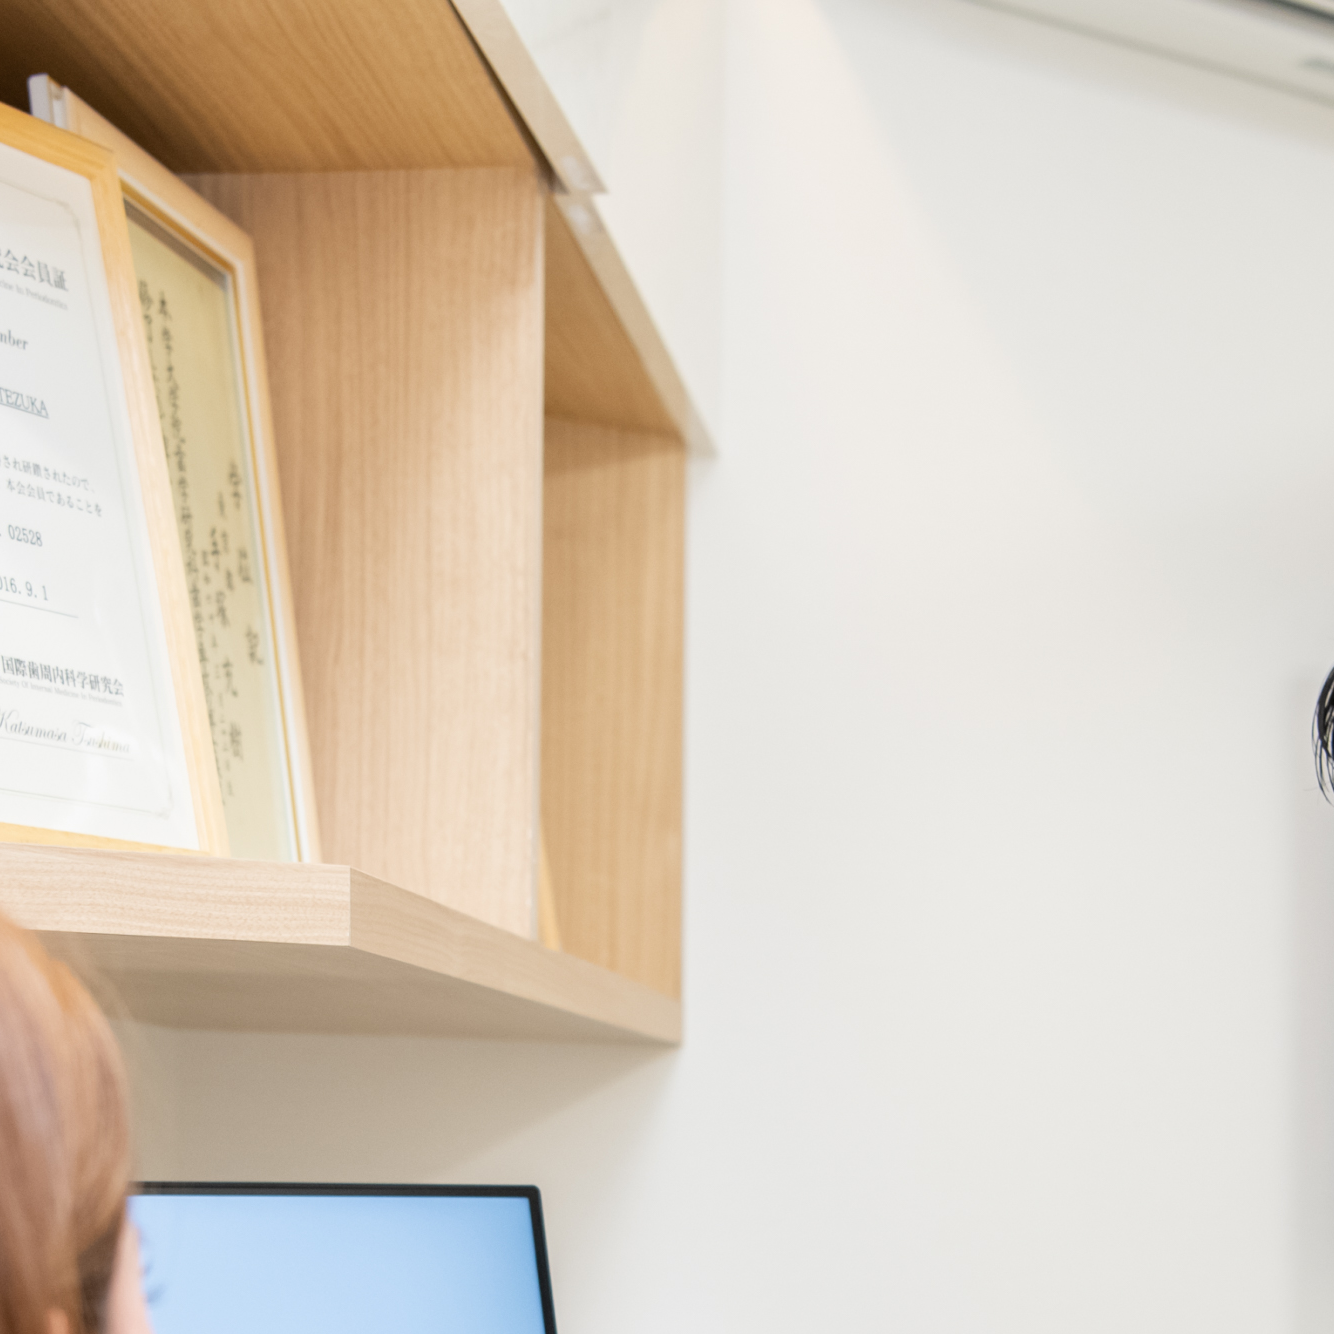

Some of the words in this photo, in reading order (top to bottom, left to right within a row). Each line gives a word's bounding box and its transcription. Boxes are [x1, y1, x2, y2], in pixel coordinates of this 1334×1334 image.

[8, 524, 43, 547] 02528
[0, 655, 124, 697] 国際歯周内科学研究会
